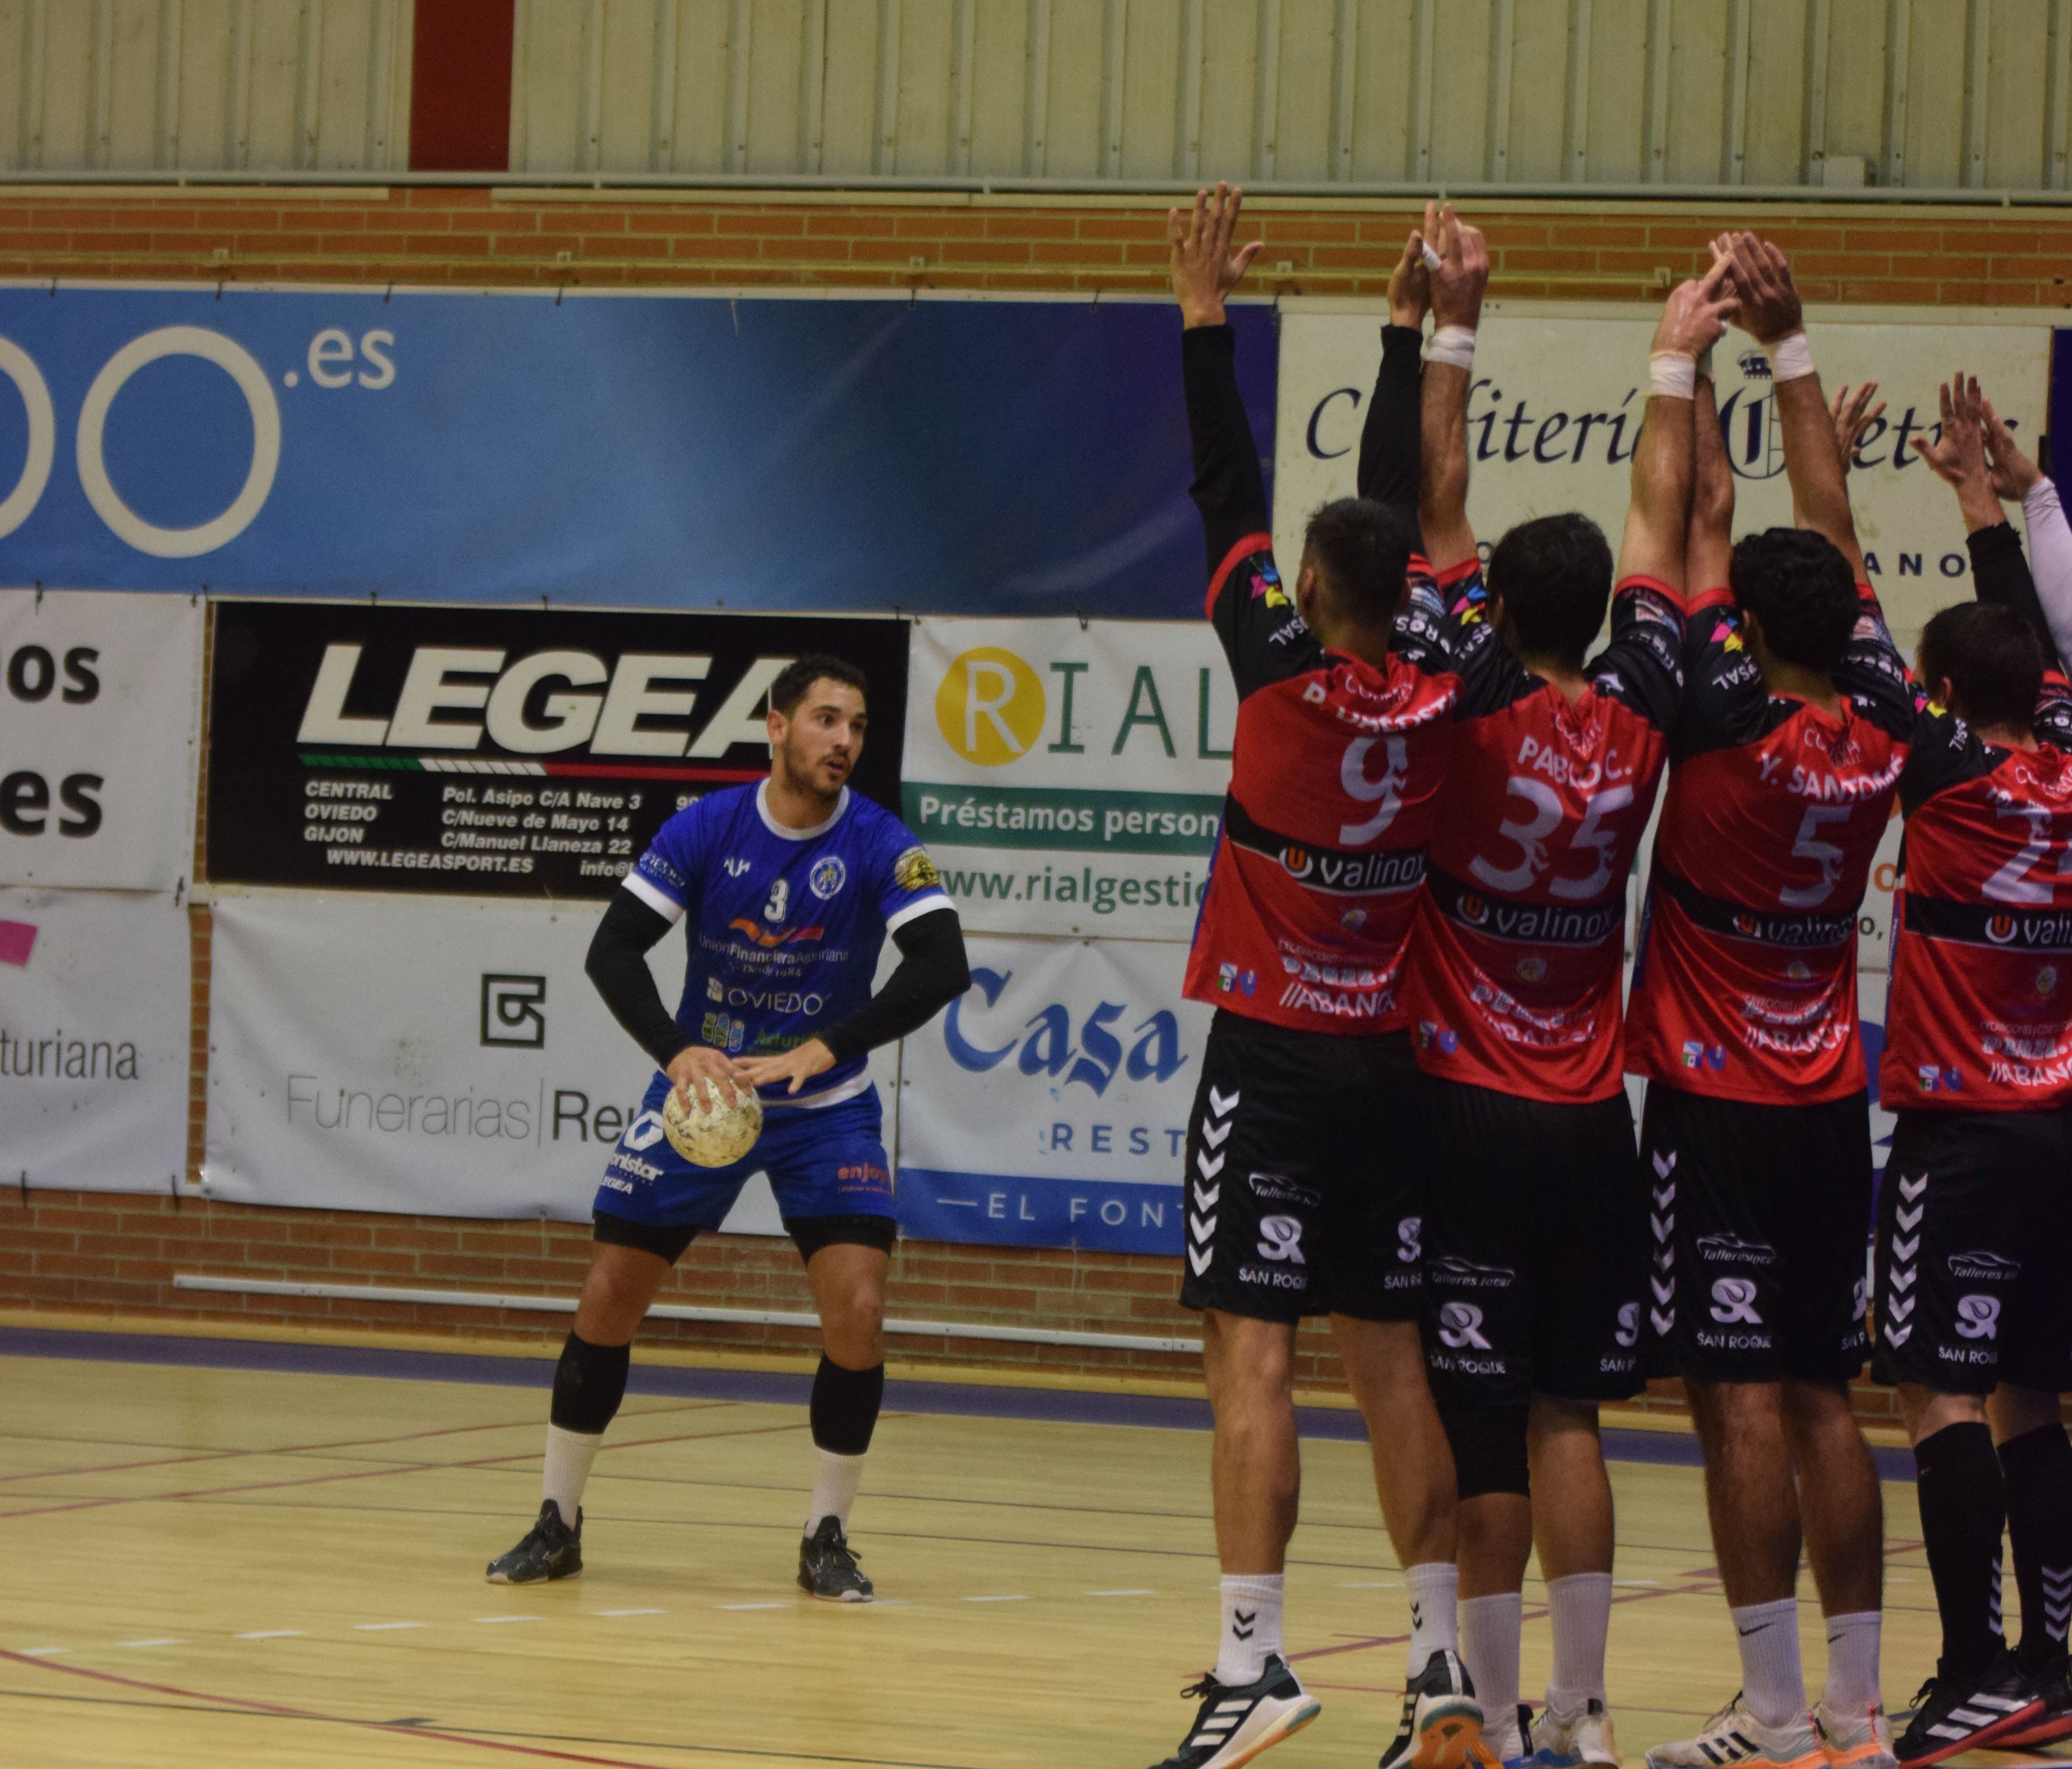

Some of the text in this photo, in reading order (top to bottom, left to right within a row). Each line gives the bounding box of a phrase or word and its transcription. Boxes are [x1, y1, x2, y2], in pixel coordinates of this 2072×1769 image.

[296, 643, 798, 758] LEGEA
[965, 660, 1233, 759] RIAL
[305, 781, 394, 800] CENTRAL
[443, 788, 477, 804] Pol.
[483, 789, 533, 808] Asipo
[540, 791, 570, 808] C/A
[576, 792, 622, 809] Nave
[629, 794, 641, 810] 3
[1340, 737, 1409, 844] 9
[305, 804, 377, 822] OVIEDO
[443, 810, 629, 833] C/Nueve de Mayo 14
[919, 794, 1219, 841] Préstamos person
[304, 826, 364, 843] GIJON
[441, 832, 631, 854] C/Manuel Llaneza 22
[1469, 776, 1634, 900] 35
[327, 848, 534, 873] WWW.LEGEASPORT.ES
[1320, 853, 1426, 888] valinox
[1779, 806, 1854, 908] 5
[764, 879, 789, 923] 3
[937, 866, 1206, 915] ww.rialgesti
[1496, 907, 1615, 939] valinox
[728, 988, 823, 1016] OVIEDO
[943, 967, 1189, 1098] Casa
[288, 1075, 530, 1139] Funerarias
[1051, 1122, 1188, 1157] REST
[988, 1192, 1184, 1228] EL FON
[1239, 1267, 1269, 1285] SAN
[1954, 1266, 2002, 1280] Talleres
[1697, 1332, 1772, 1349] SAN ROQUE
[1938, 1346, 1966, 1363] SAN
[1458, 1358, 1506, 1375] ROQUE
[1600, 1357, 1626, 1373] SAN
